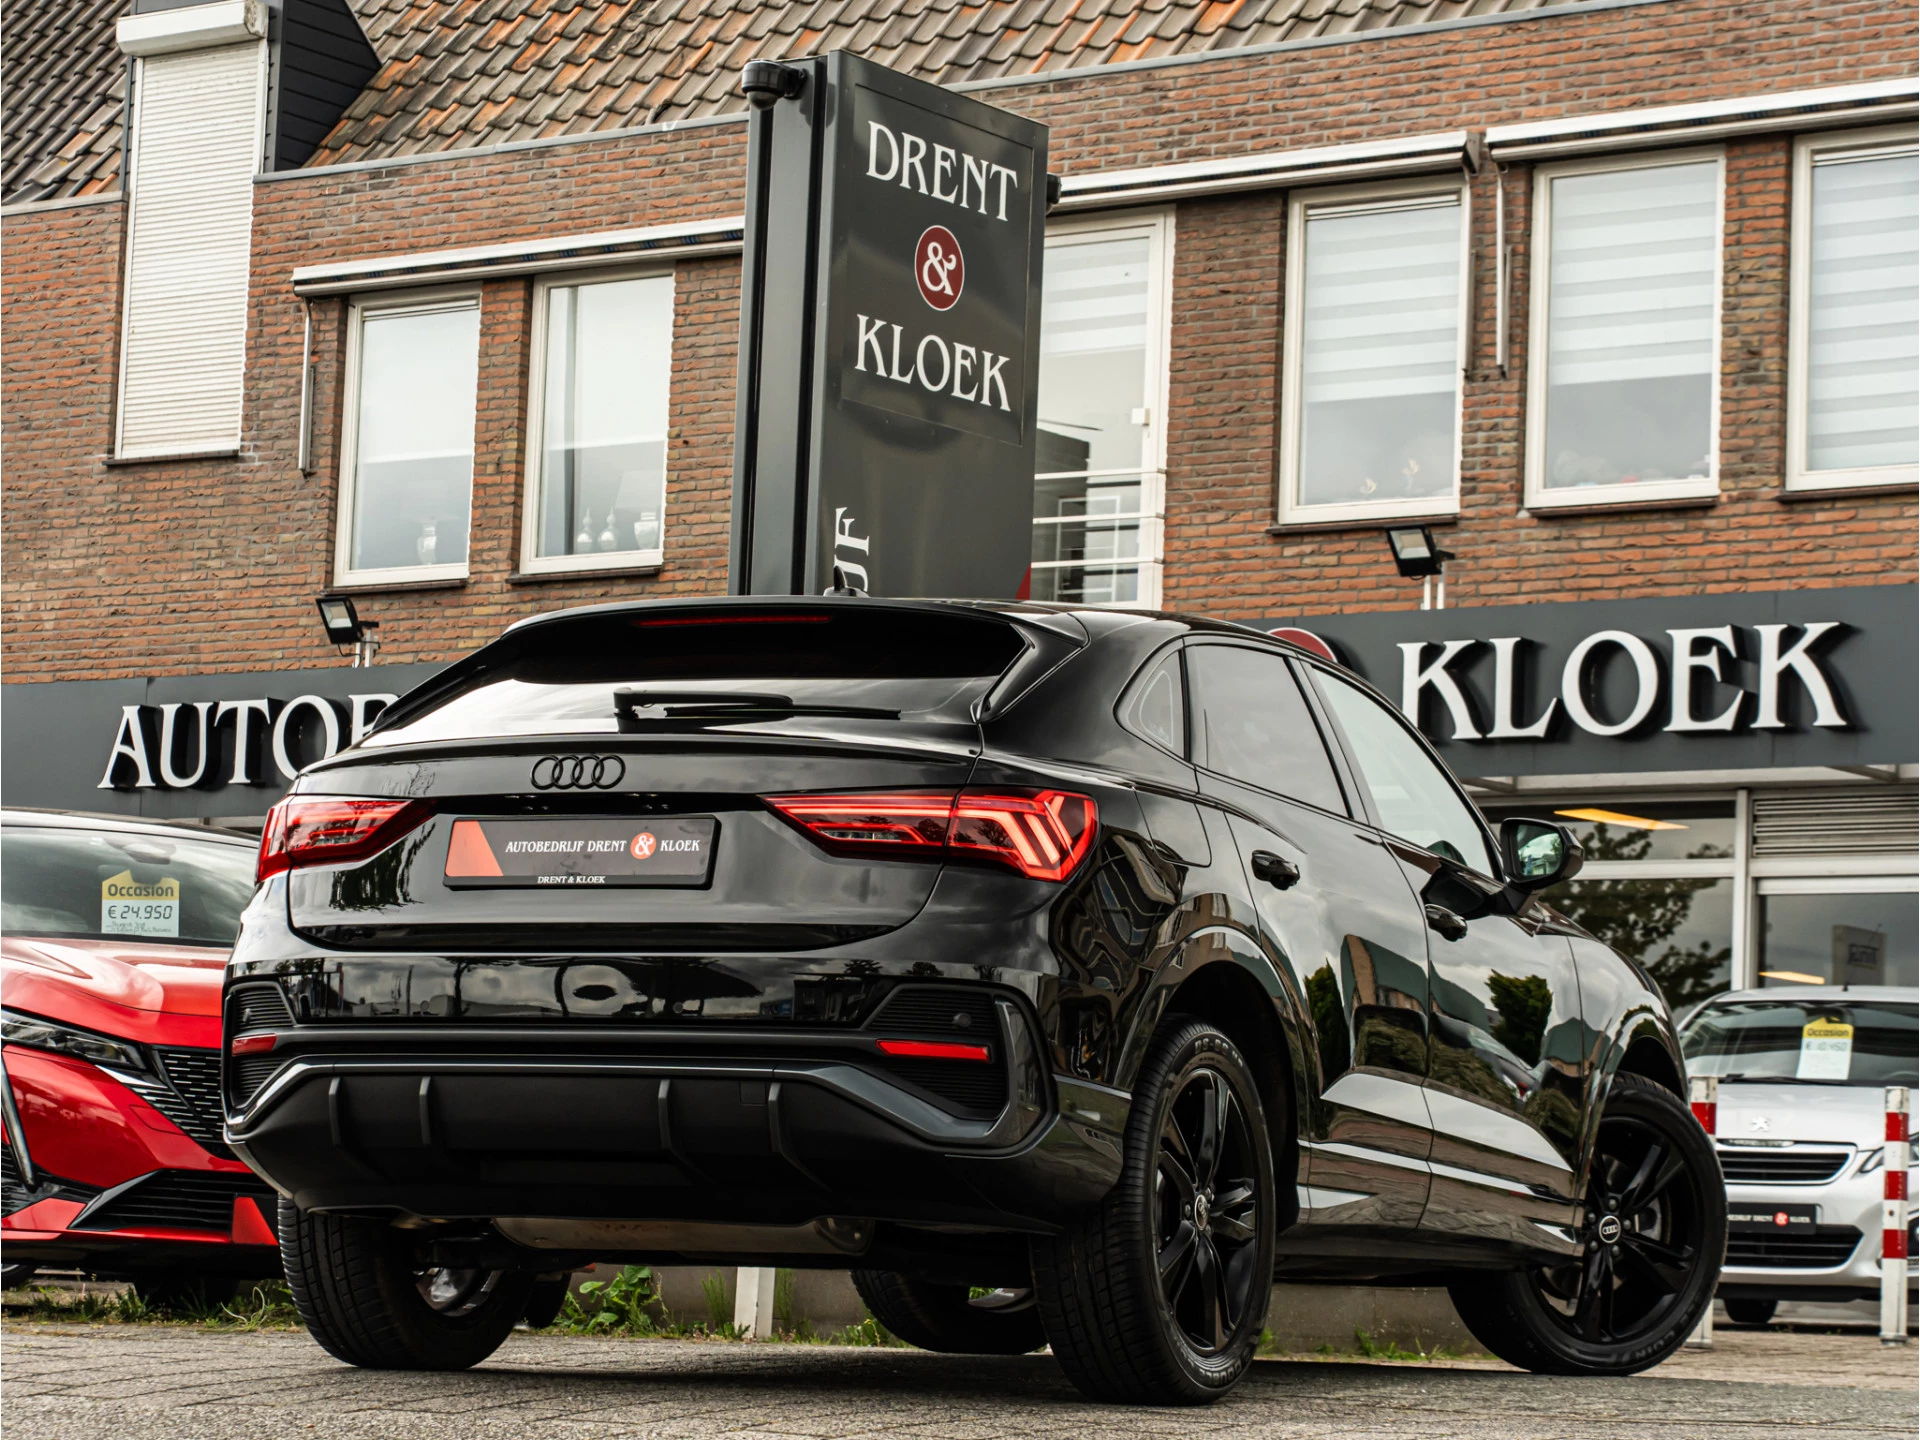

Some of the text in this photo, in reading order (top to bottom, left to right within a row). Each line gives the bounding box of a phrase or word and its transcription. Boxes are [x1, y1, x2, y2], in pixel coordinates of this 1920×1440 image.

[865, 120, 1017, 222] DRENT
[922, 241, 957, 296] &
[854, 313, 1012, 413] KLOEK
[1396, 621, 1848, 741] KLOEK
[505, 834, 701, 856] AUTOBEDRIJF DRENT & KLOEK
[108, 884, 174, 897] Occasion
[537, 875, 606, 884] DRENT & KLOEK
[120, 905, 173, 919] 24.950
